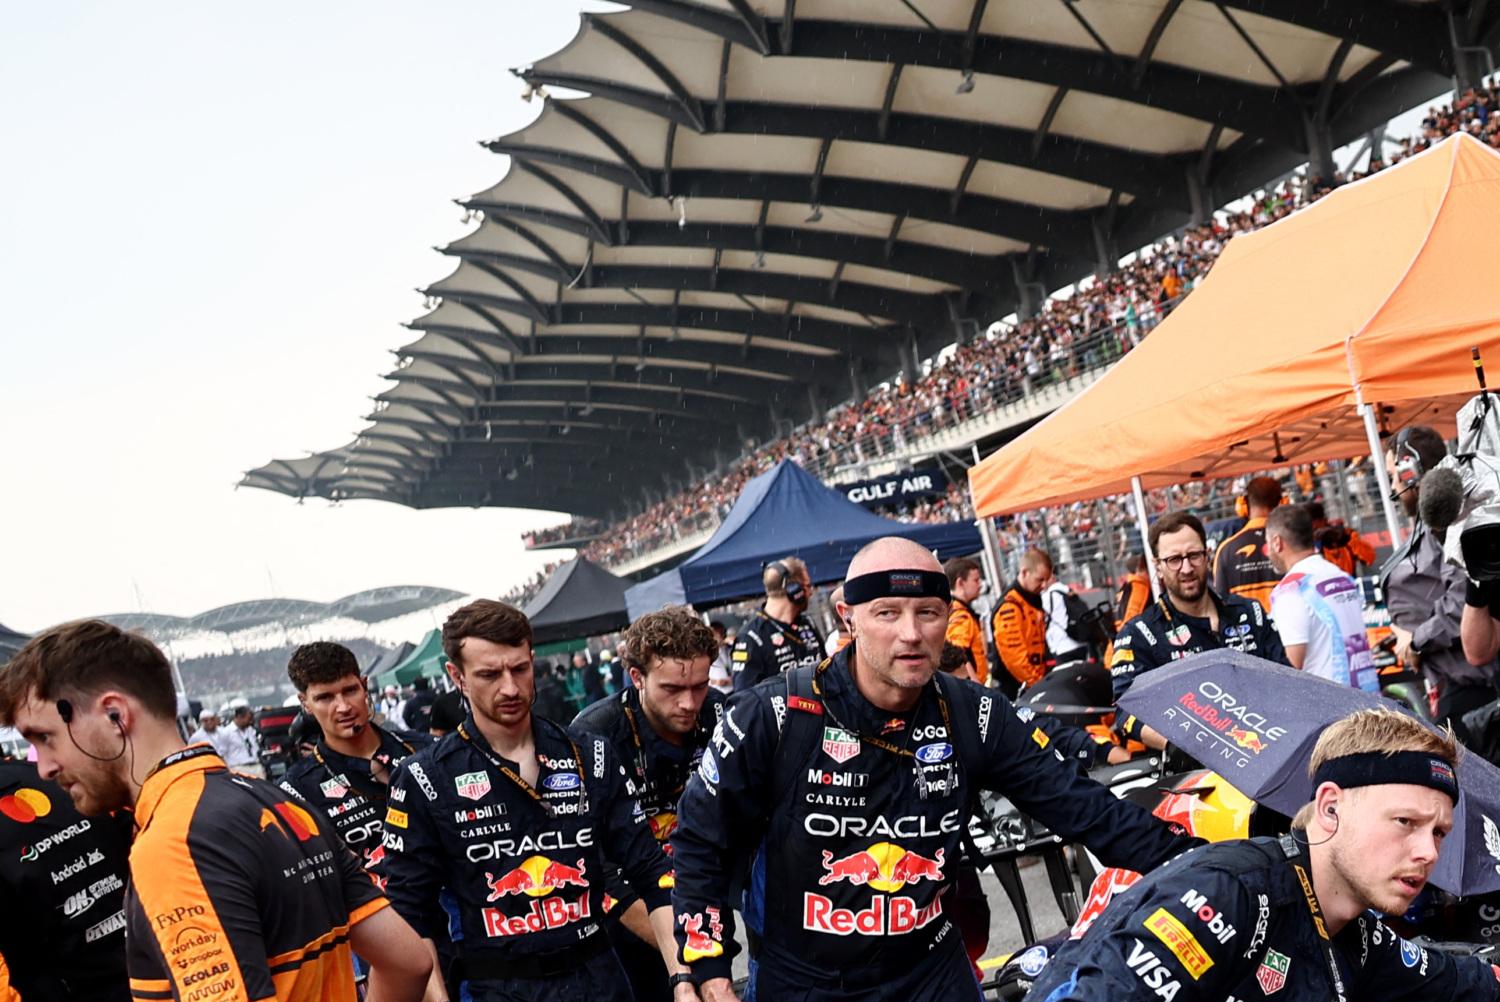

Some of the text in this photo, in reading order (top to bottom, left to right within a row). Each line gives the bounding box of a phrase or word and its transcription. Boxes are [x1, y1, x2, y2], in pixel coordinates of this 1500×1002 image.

[848, 475, 932, 503] GULF AIR
[771, 696, 787, 733] spa
[798, 700, 815, 711] YETI
[1199, 681, 1288, 742] ORACLE
[824, 742, 859, 756] HEUER
[1163, 708, 1250, 769] RACING
[550, 758, 576, 770] Gat
[593, 739, 605, 779] sparco
[408, 762, 437, 801] sparco
[458, 773, 486, 785] TAG
[550, 776, 577, 788] Ford
[808, 769, 852, 787] Mobil
[327, 797, 357, 818] Mobil
[455, 805, 493, 823] Mobil
[806, 793, 866, 808] CARLYLE
[337, 807, 377, 828] CARLYLE
[460, 822, 511, 838] CARLYLE
[804, 809, 961, 839] ORACLE
[36, 819, 92, 854] DP WORLD
[466, 827, 594, 863] ORACLE
[51, 857, 87, 886] Android
[156, 903, 205, 931] FxPro
[482, 900, 545, 938] Red
[804, 892, 885, 936] Red
[1180, 889, 1236, 944] Mobil
[170, 932, 217, 956] workday
[1153, 915, 1207, 973] PIRELLI
[183, 962, 230, 987] ECOLAB
[1264, 950, 1287, 973] TAG
[1420, 948, 1429, 976] RAC
[1256, 965, 1284, 993] HEUER
